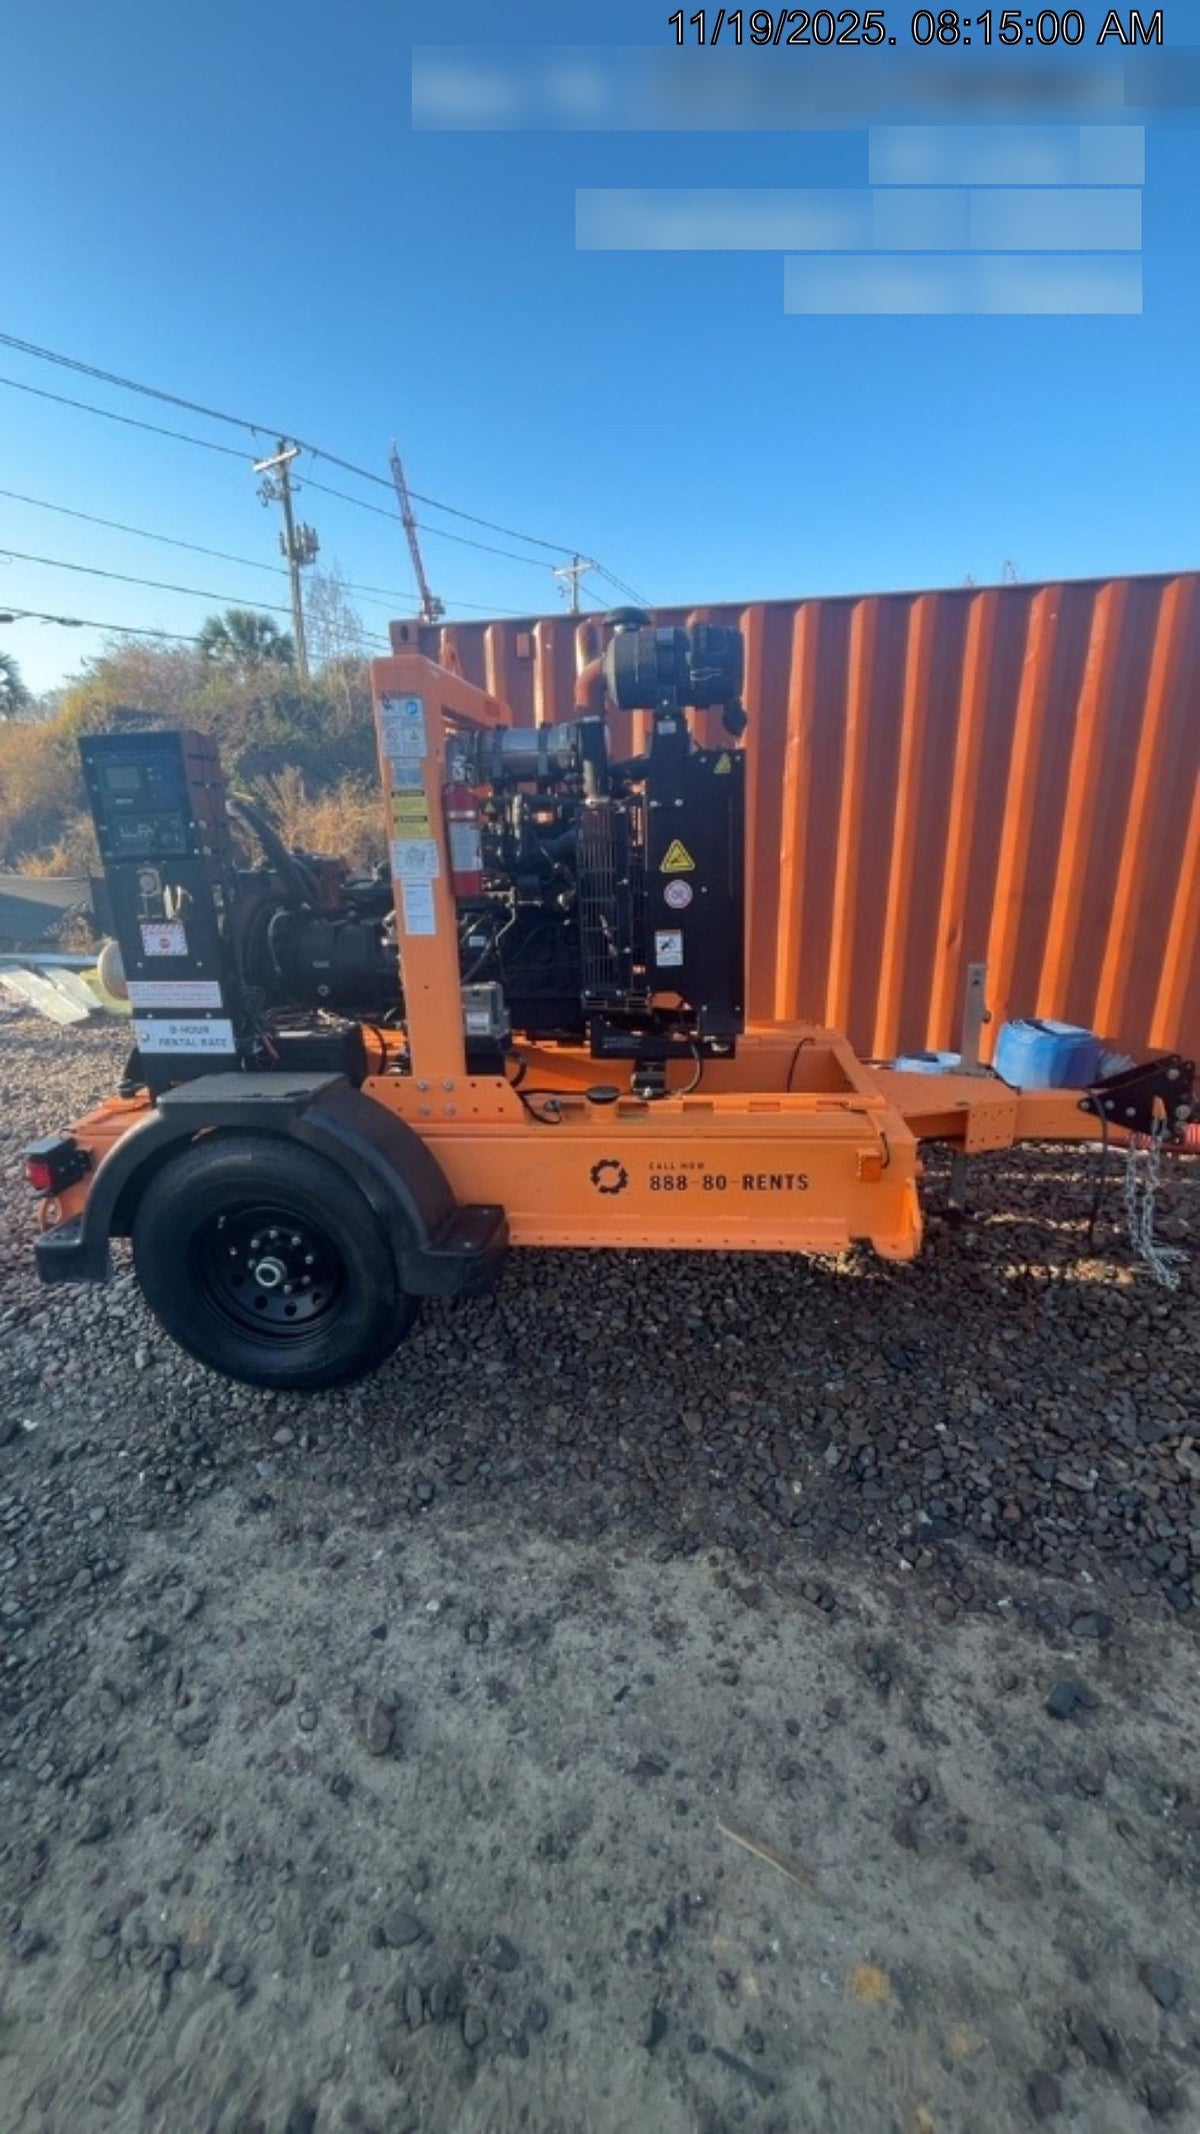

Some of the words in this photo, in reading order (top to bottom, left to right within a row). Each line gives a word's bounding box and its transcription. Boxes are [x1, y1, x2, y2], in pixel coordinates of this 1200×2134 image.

[158, 1037, 198, 1047] RENTAL
[201, 1037, 227, 1047] RATE
[648, 1161, 676, 1170] CALL
